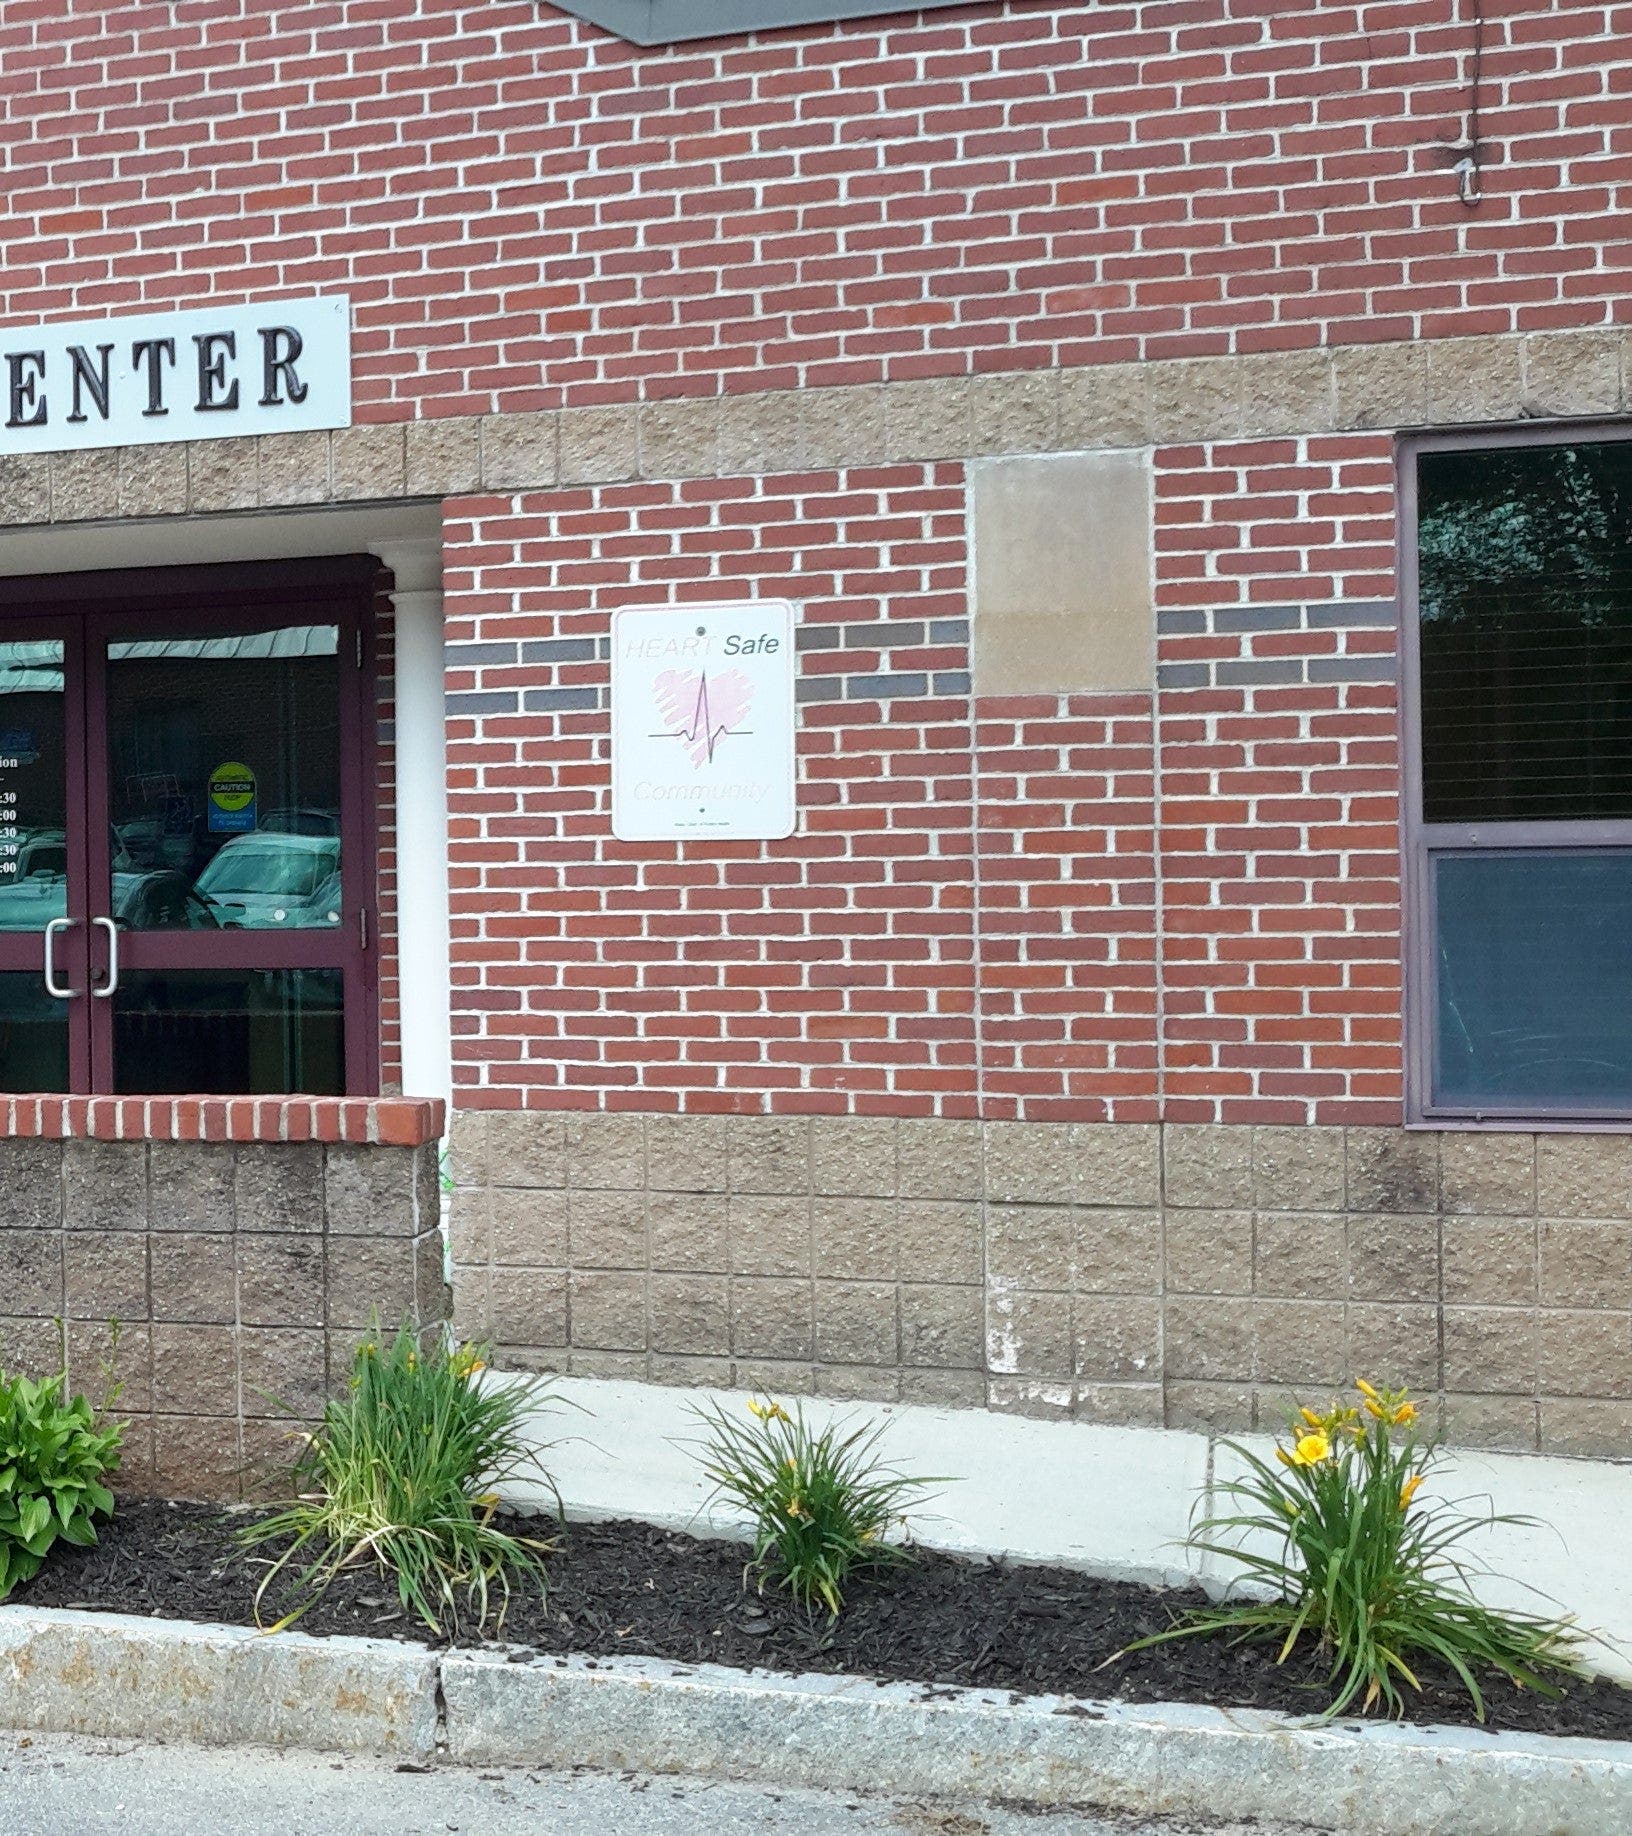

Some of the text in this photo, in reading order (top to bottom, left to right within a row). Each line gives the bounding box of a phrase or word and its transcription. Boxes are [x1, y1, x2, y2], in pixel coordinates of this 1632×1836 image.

[625, 634, 780, 659] HEART Safe
[213, 783, 251, 792] CAUTION
[634, 780, 774, 805] Community
